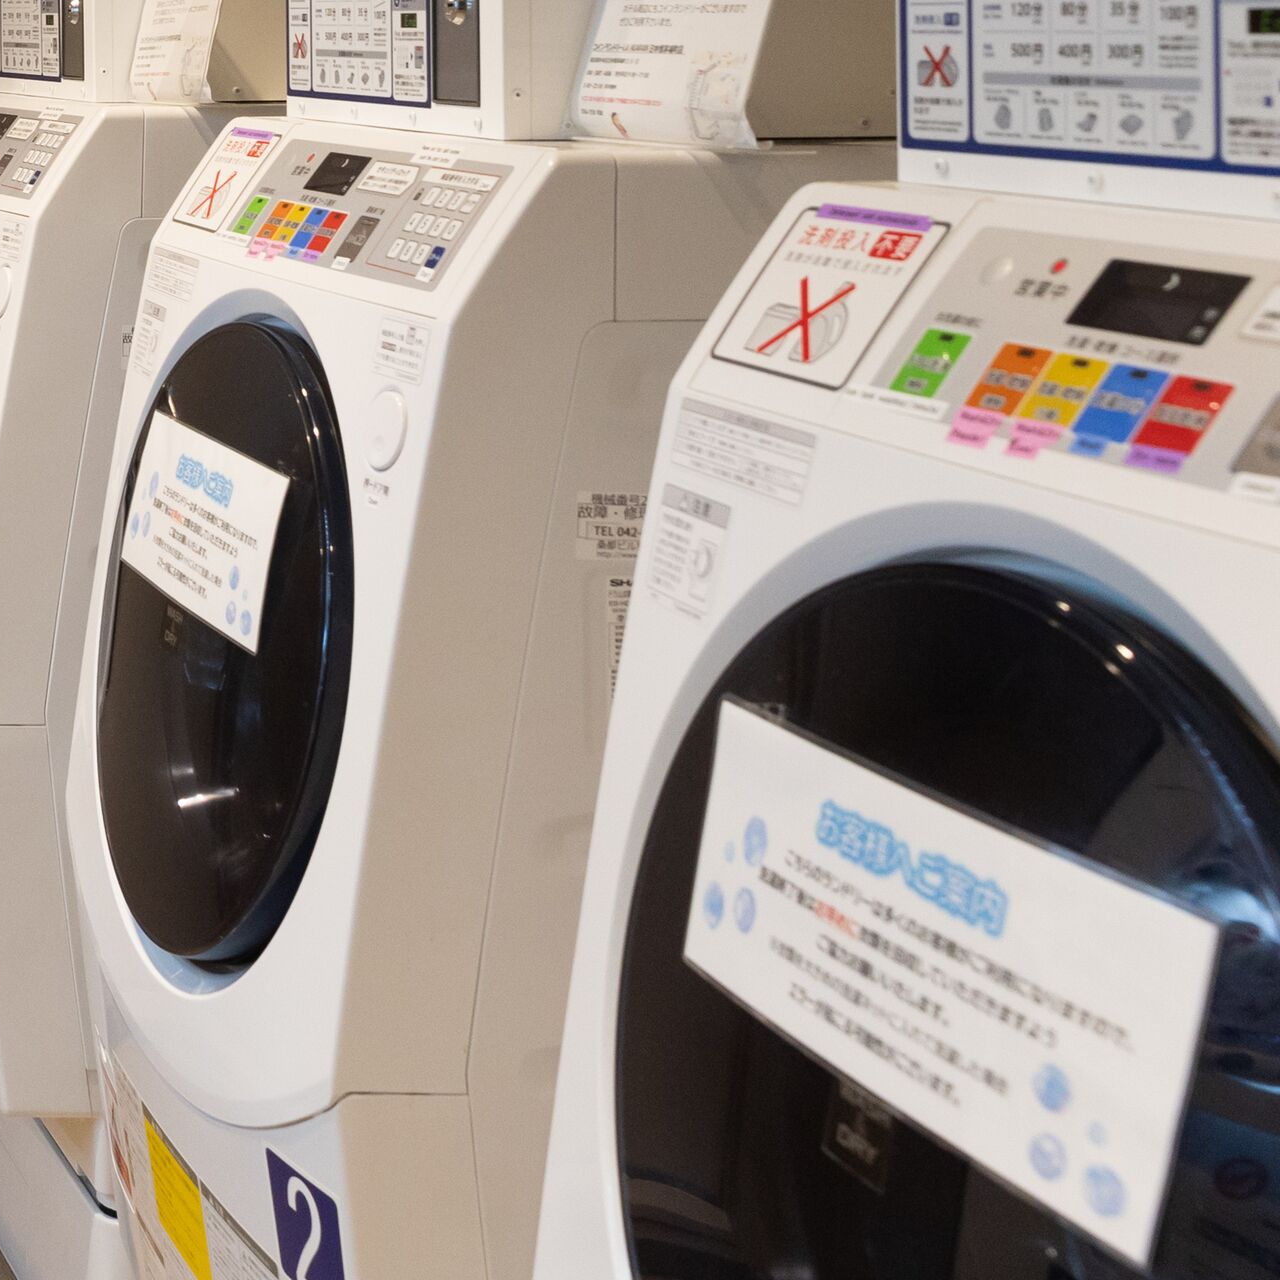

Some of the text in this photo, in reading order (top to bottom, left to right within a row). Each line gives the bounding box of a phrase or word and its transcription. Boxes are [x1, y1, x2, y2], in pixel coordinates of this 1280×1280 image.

[797, 223, 876, 253] 洗剤投入
[594, 525, 613, 536] TEL
[814, 795, 1010, 941] お客様へご案内
